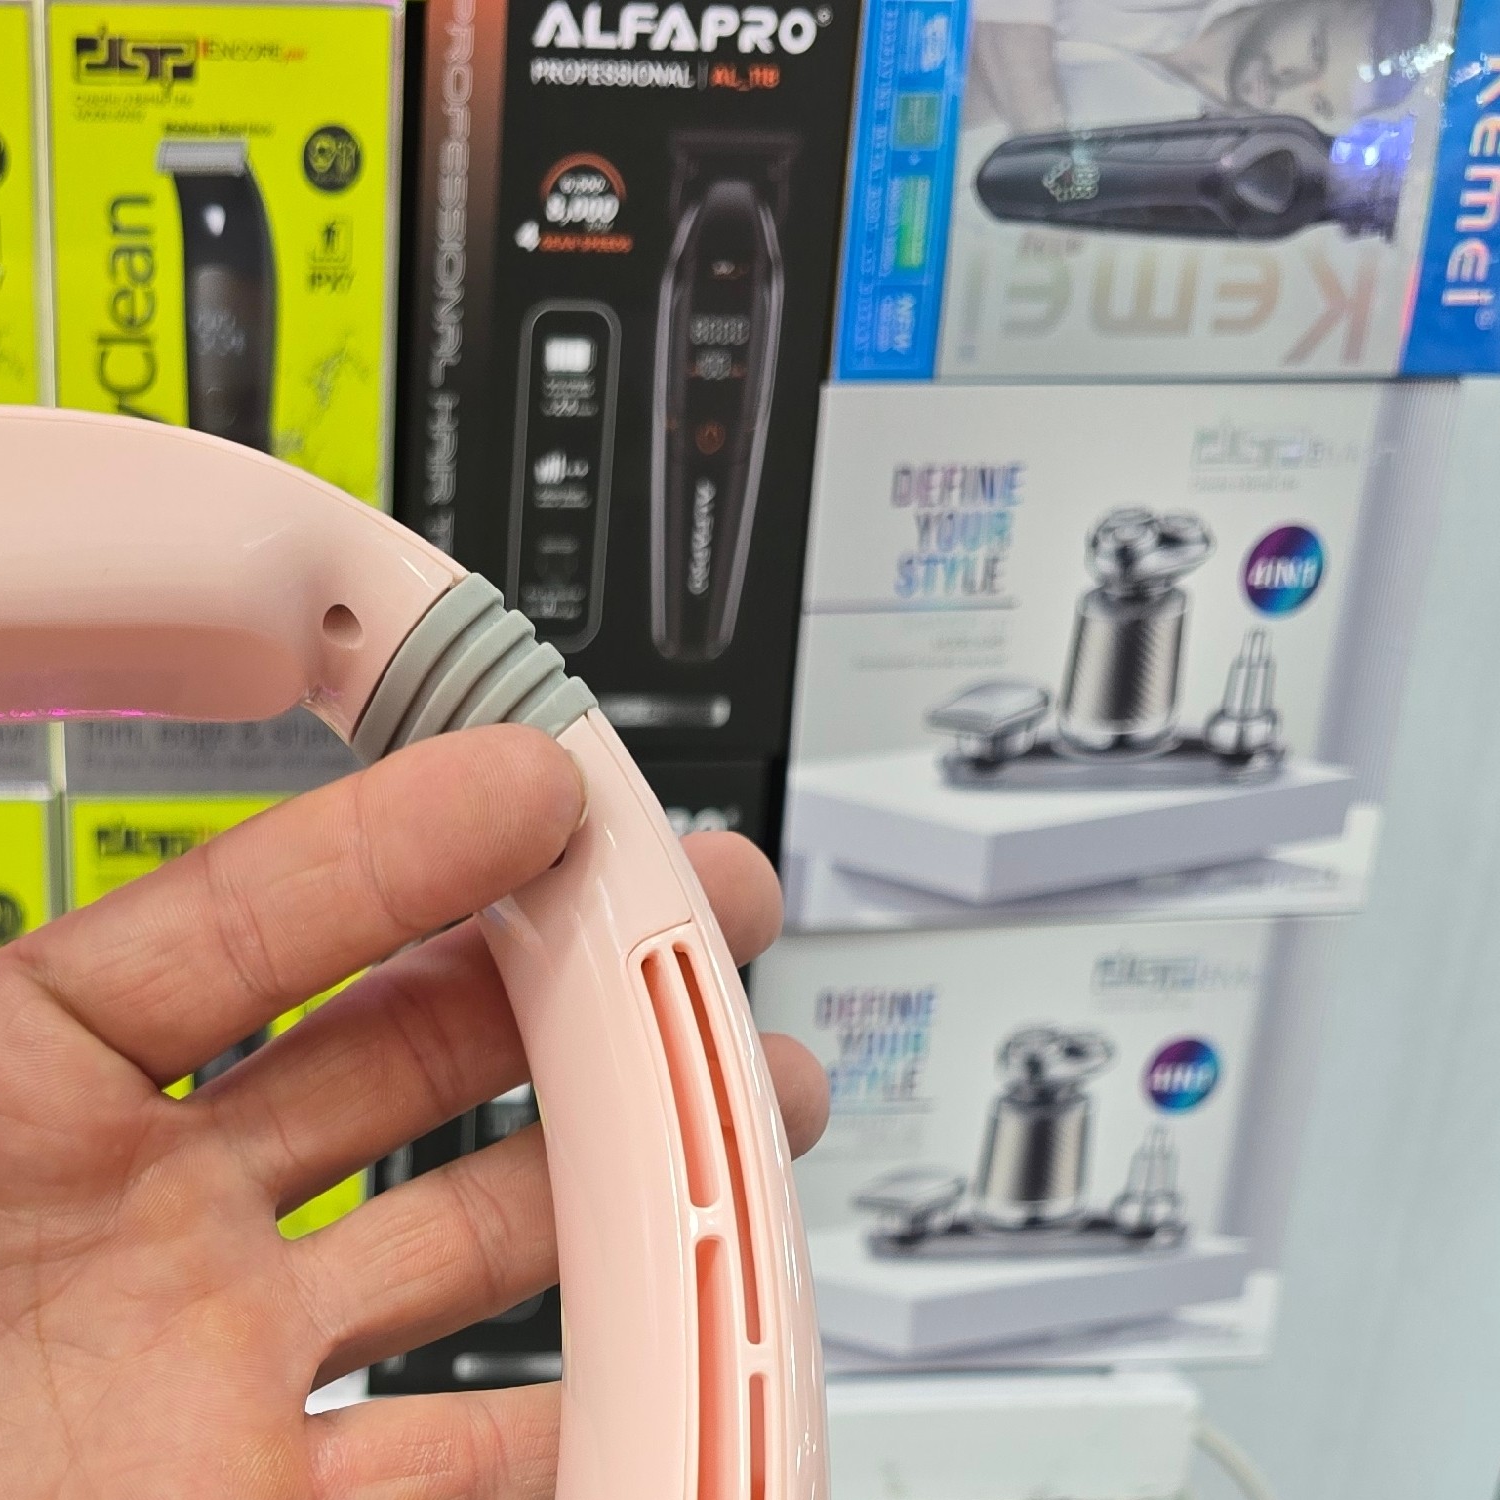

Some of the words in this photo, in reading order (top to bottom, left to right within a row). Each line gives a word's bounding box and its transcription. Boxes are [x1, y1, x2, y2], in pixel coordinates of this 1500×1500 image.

[531, 1, 817, 55] ALFAPRO
[530, 57, 696, 88] PROFESSIONAL
[891, 463, 1026, 507] DEFINE
[914, 511, 1011, 550] YOUR
[894, 554, 1004, 597] STYLE
